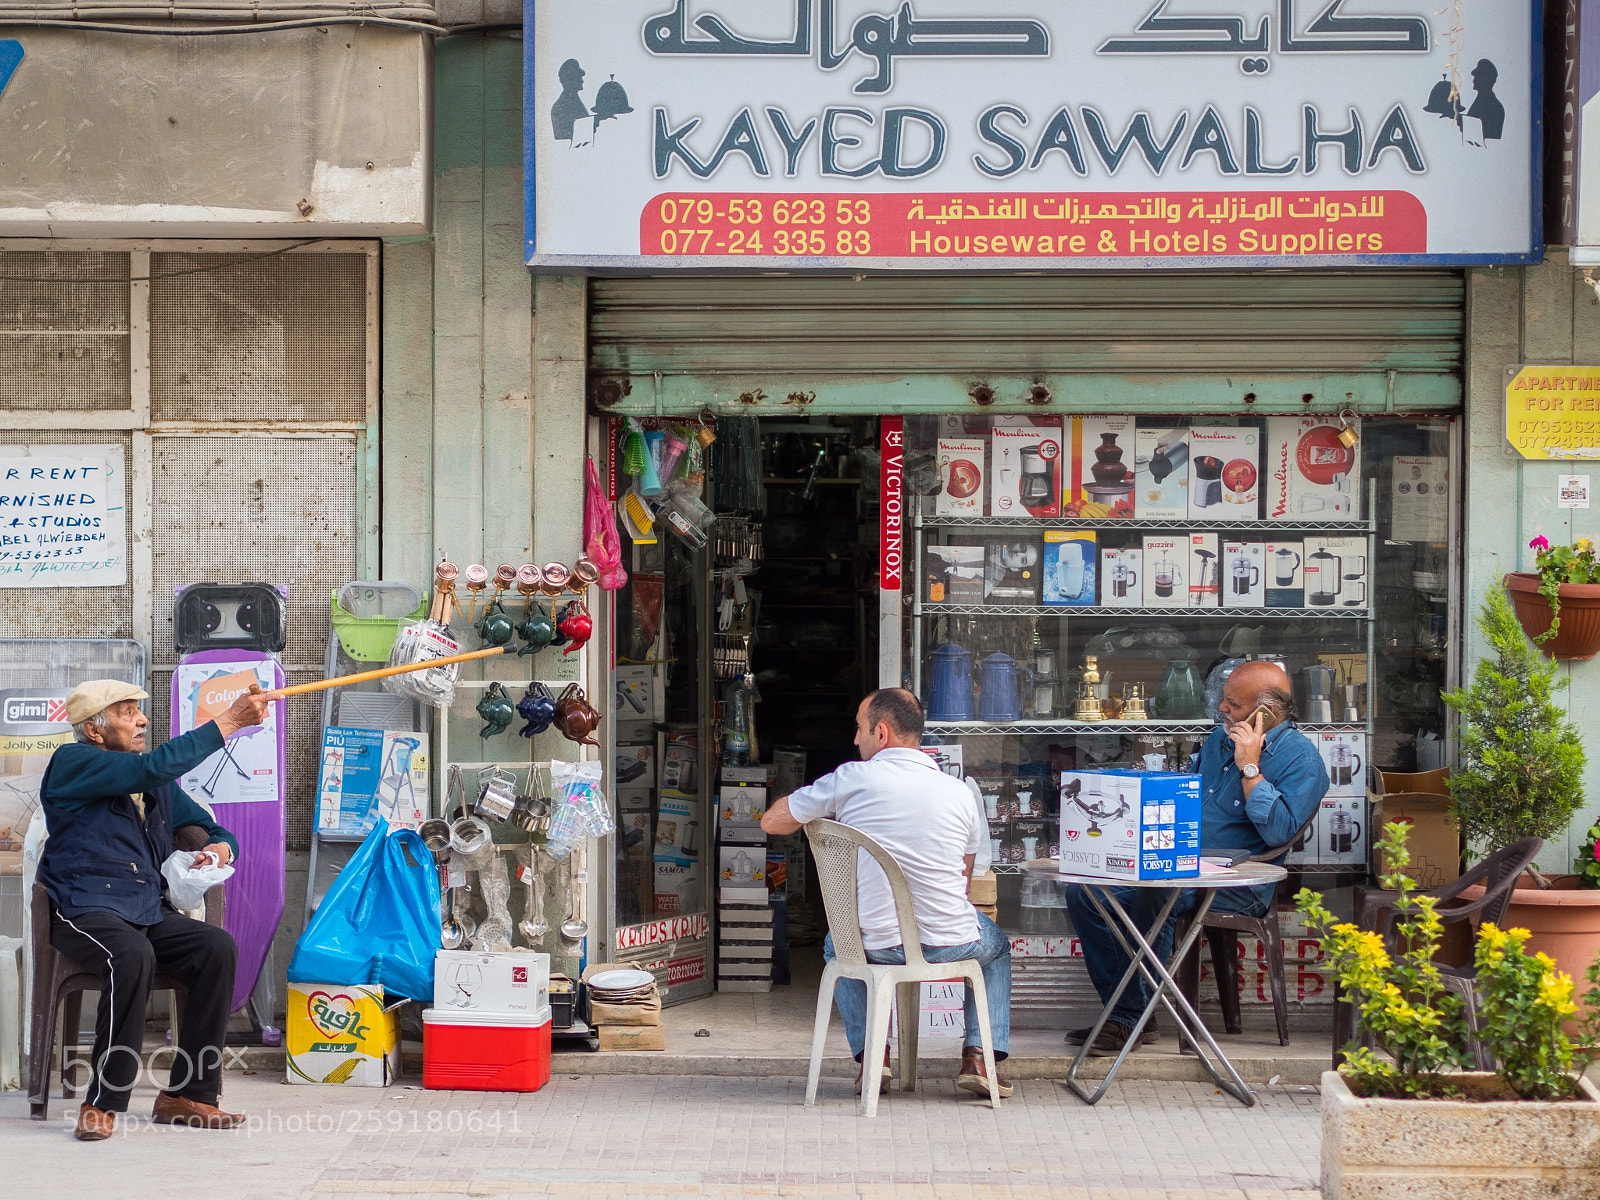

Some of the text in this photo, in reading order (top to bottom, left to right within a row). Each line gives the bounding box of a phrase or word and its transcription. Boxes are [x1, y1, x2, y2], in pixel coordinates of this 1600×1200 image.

[654, 104, 1426, 177] KAYED SAWALHA
[660, 199, 871, 225] 079-53 623 53
[907, 196, 1384, 225] للأدوات المنزلية والتجهيزات الفندقية
[660, 229, 871, 254] 077-24 335 83
[910, 229, 1383, 254] Houseware & Hotels Suppliers
[1525, 396, 1564, 411] FOR
[994, 427, 1041, 438] Moulinex
[1191, 430, 1237, 440] Moulinex
[939, 441, 983, 451] Moulinex
[30, 468, 99, 479] RENT
[1271, 440, 1288, 518] Moulinex
[885, 454, 902, 580] VICTORINOX
[0, 534, 30, 545] BEL
[1147, 541, 1175, 550] guzzini
[8, 702, 46, 719] gimi
[4, 740, 64, 751] Jolly Silv
[1062, 850, 1100, 864] CLASSICA
[1143, 859, 1173, 870] CLASSICA
[618, 920, 667, 949] KRUPS
[313, 998, 371, 1041] عافية
